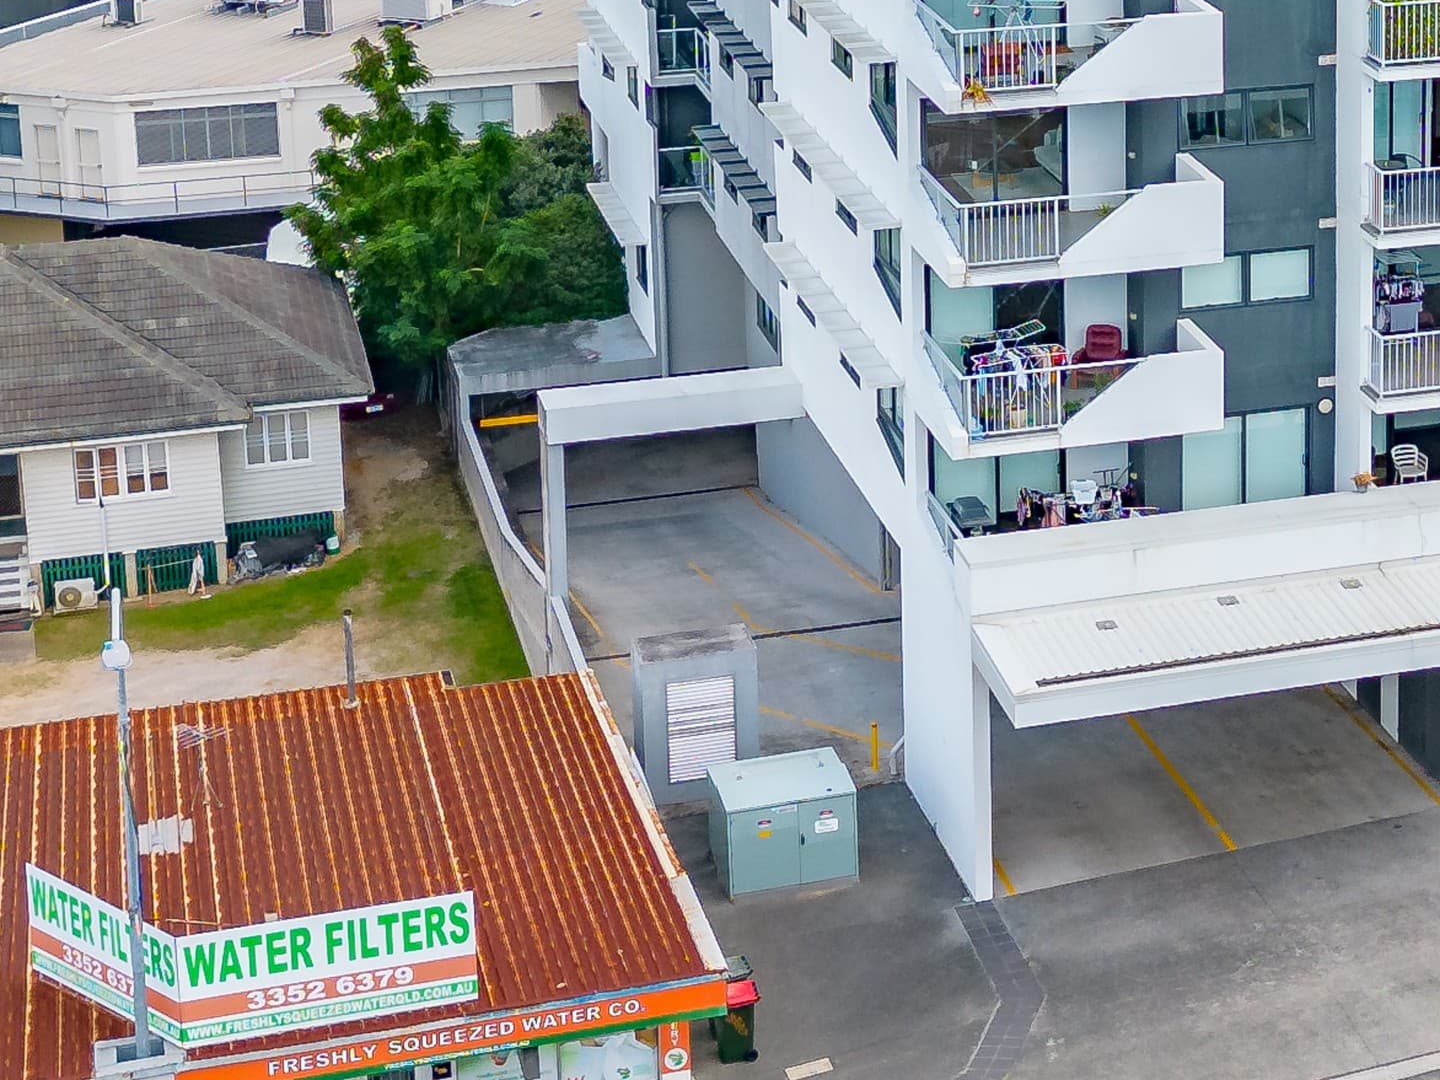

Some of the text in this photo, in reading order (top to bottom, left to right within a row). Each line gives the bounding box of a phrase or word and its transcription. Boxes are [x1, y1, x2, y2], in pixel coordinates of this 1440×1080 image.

[30, 875, 95, 946] WATER
[183, 901, 470, 987] WATER FILTERS
[62, 944, 134, 996] 3352 637
[246, 966, 414, 1010] 3352 6379
[268, 1044, 377, 1077] FRESHLY
[388, 1022, 514, 1055] SQUEEZED
[522, 1005, 601, 1032] WATER
[608, 999, 646, 1017] CO.
